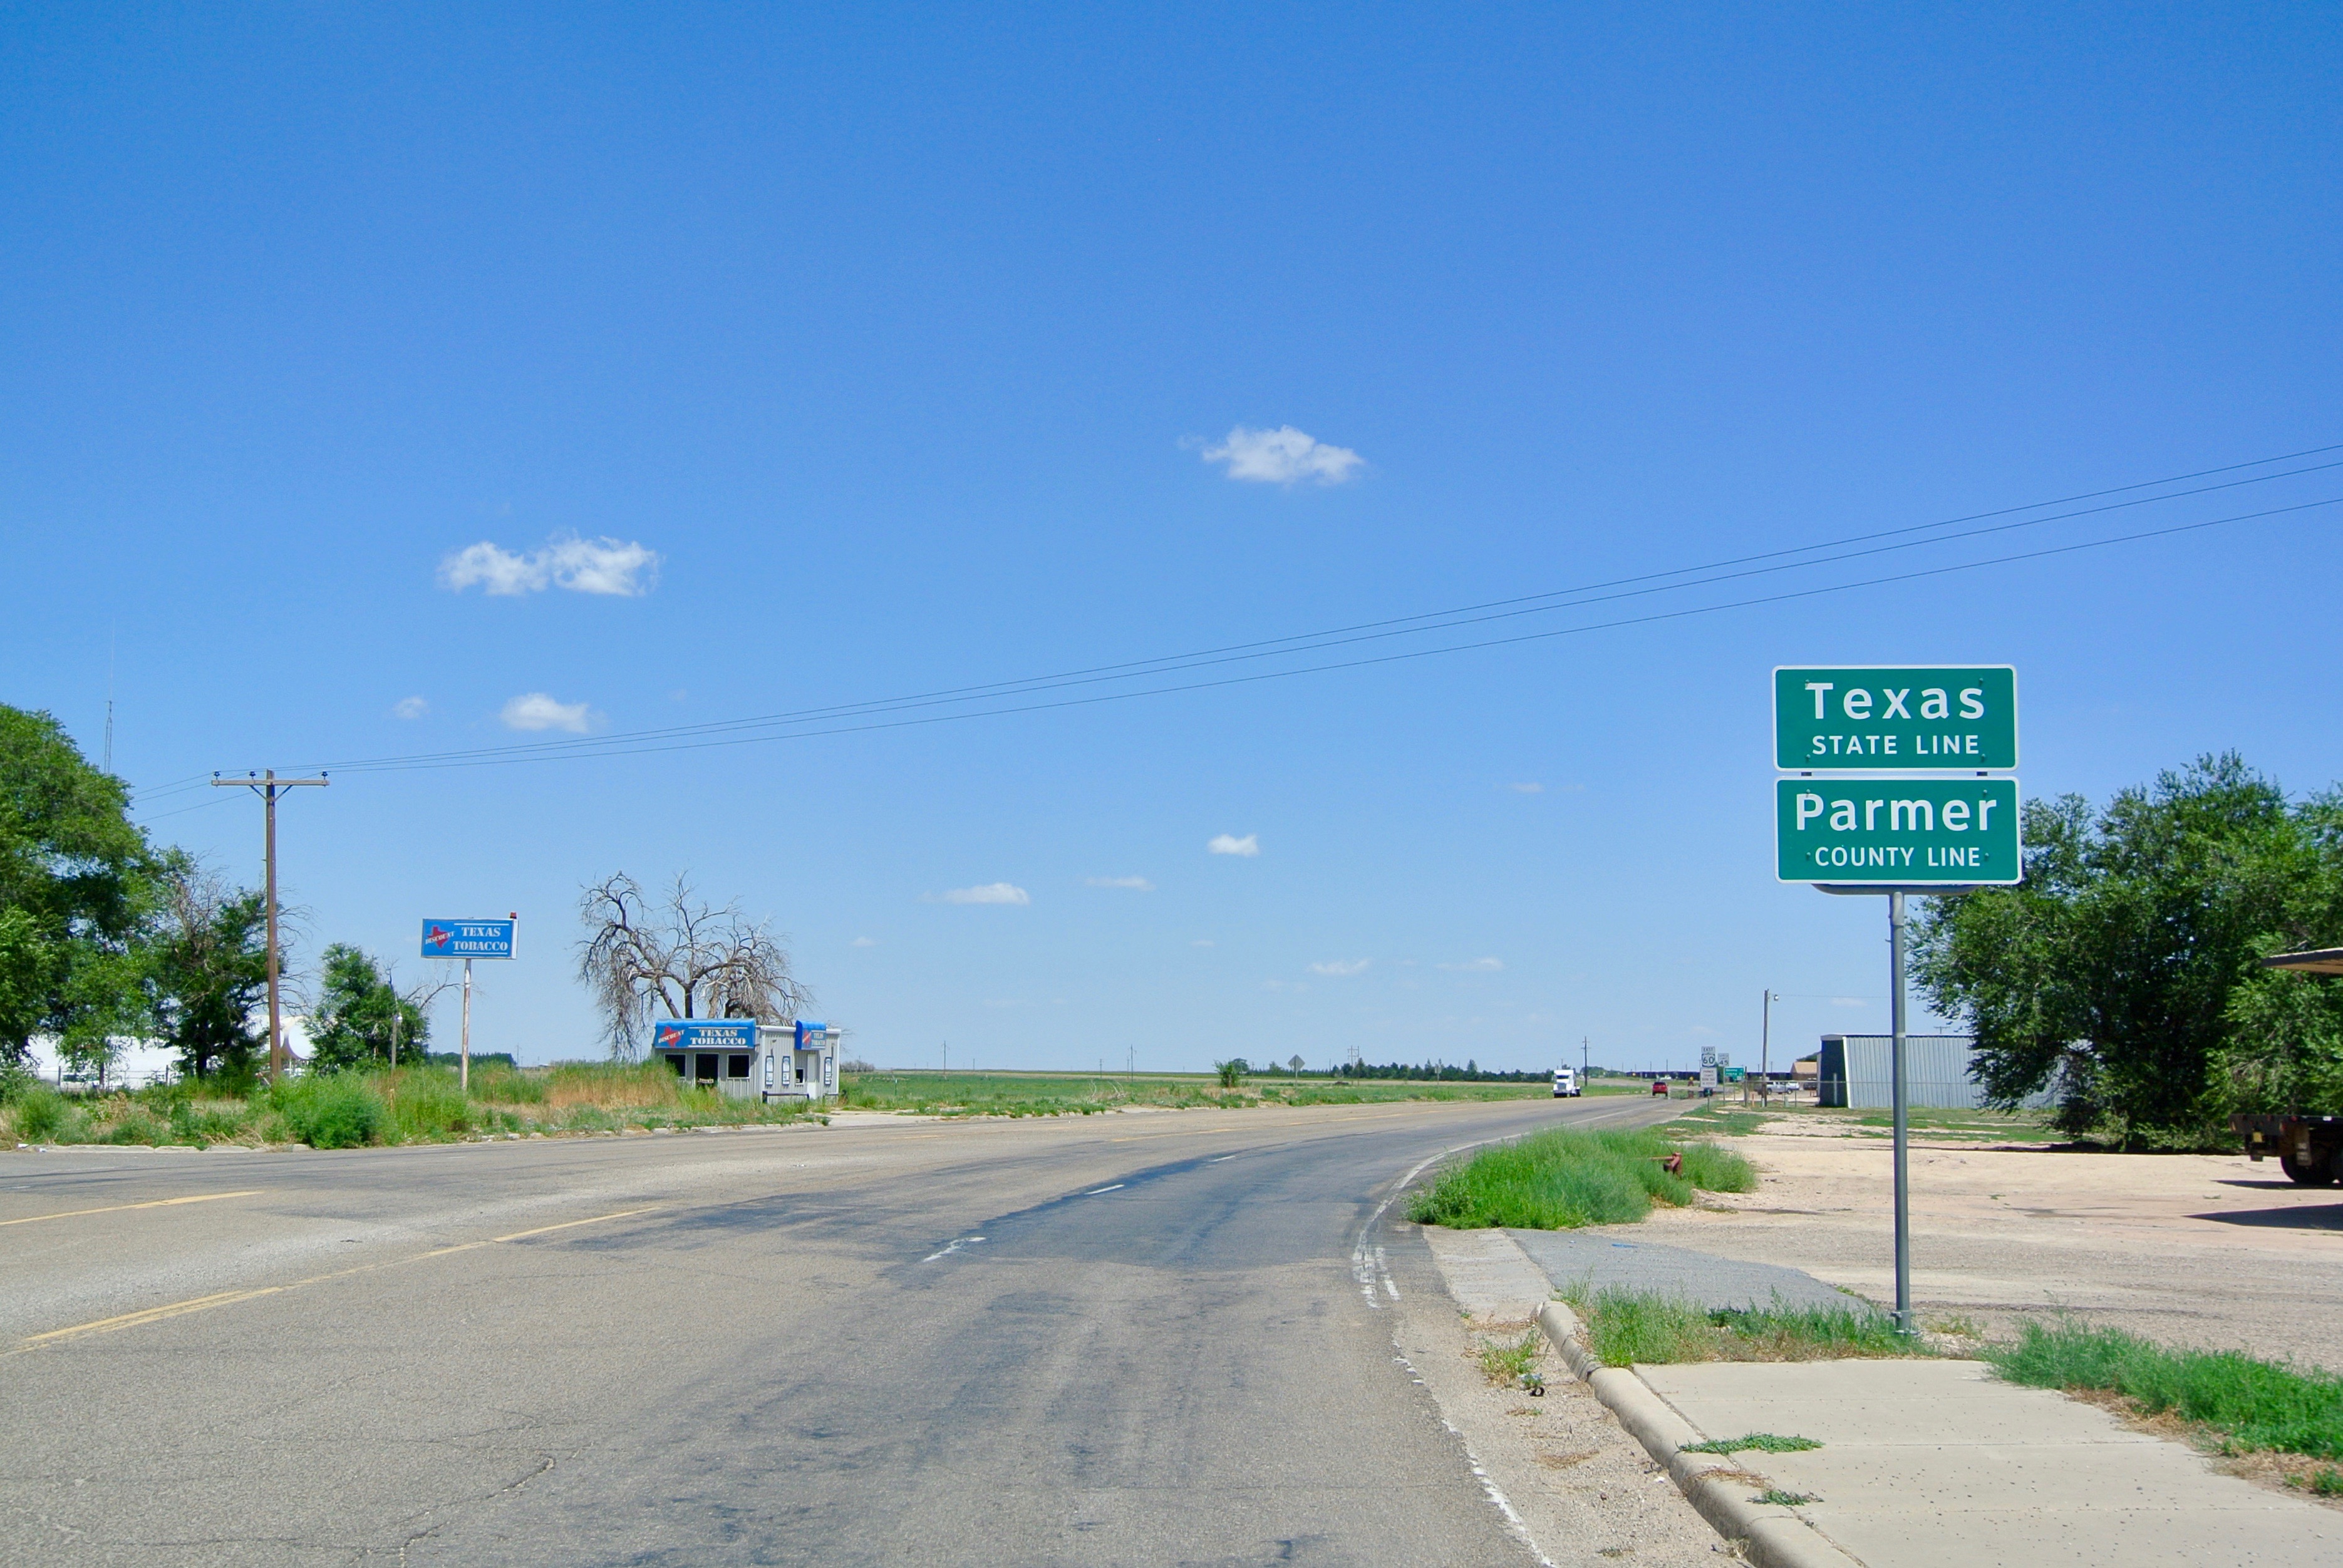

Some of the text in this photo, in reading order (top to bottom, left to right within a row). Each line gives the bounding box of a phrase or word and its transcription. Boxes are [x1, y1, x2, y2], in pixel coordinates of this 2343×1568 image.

[1805, 683, 1985, 720] Texas
[1812, 735, 1979, 755] STATE LINE
[1796, 793, 1997, 831] Parmer
[1815, 847, 1980, 867] COUNTY LINE
[425, 931, 455, 944] DISCOUNT
[462, 927, 500, 937] TEXAS
[453, 941, 508, 951] TOBACCO
[658, 1029, 685, 1043] DISCOUNT
